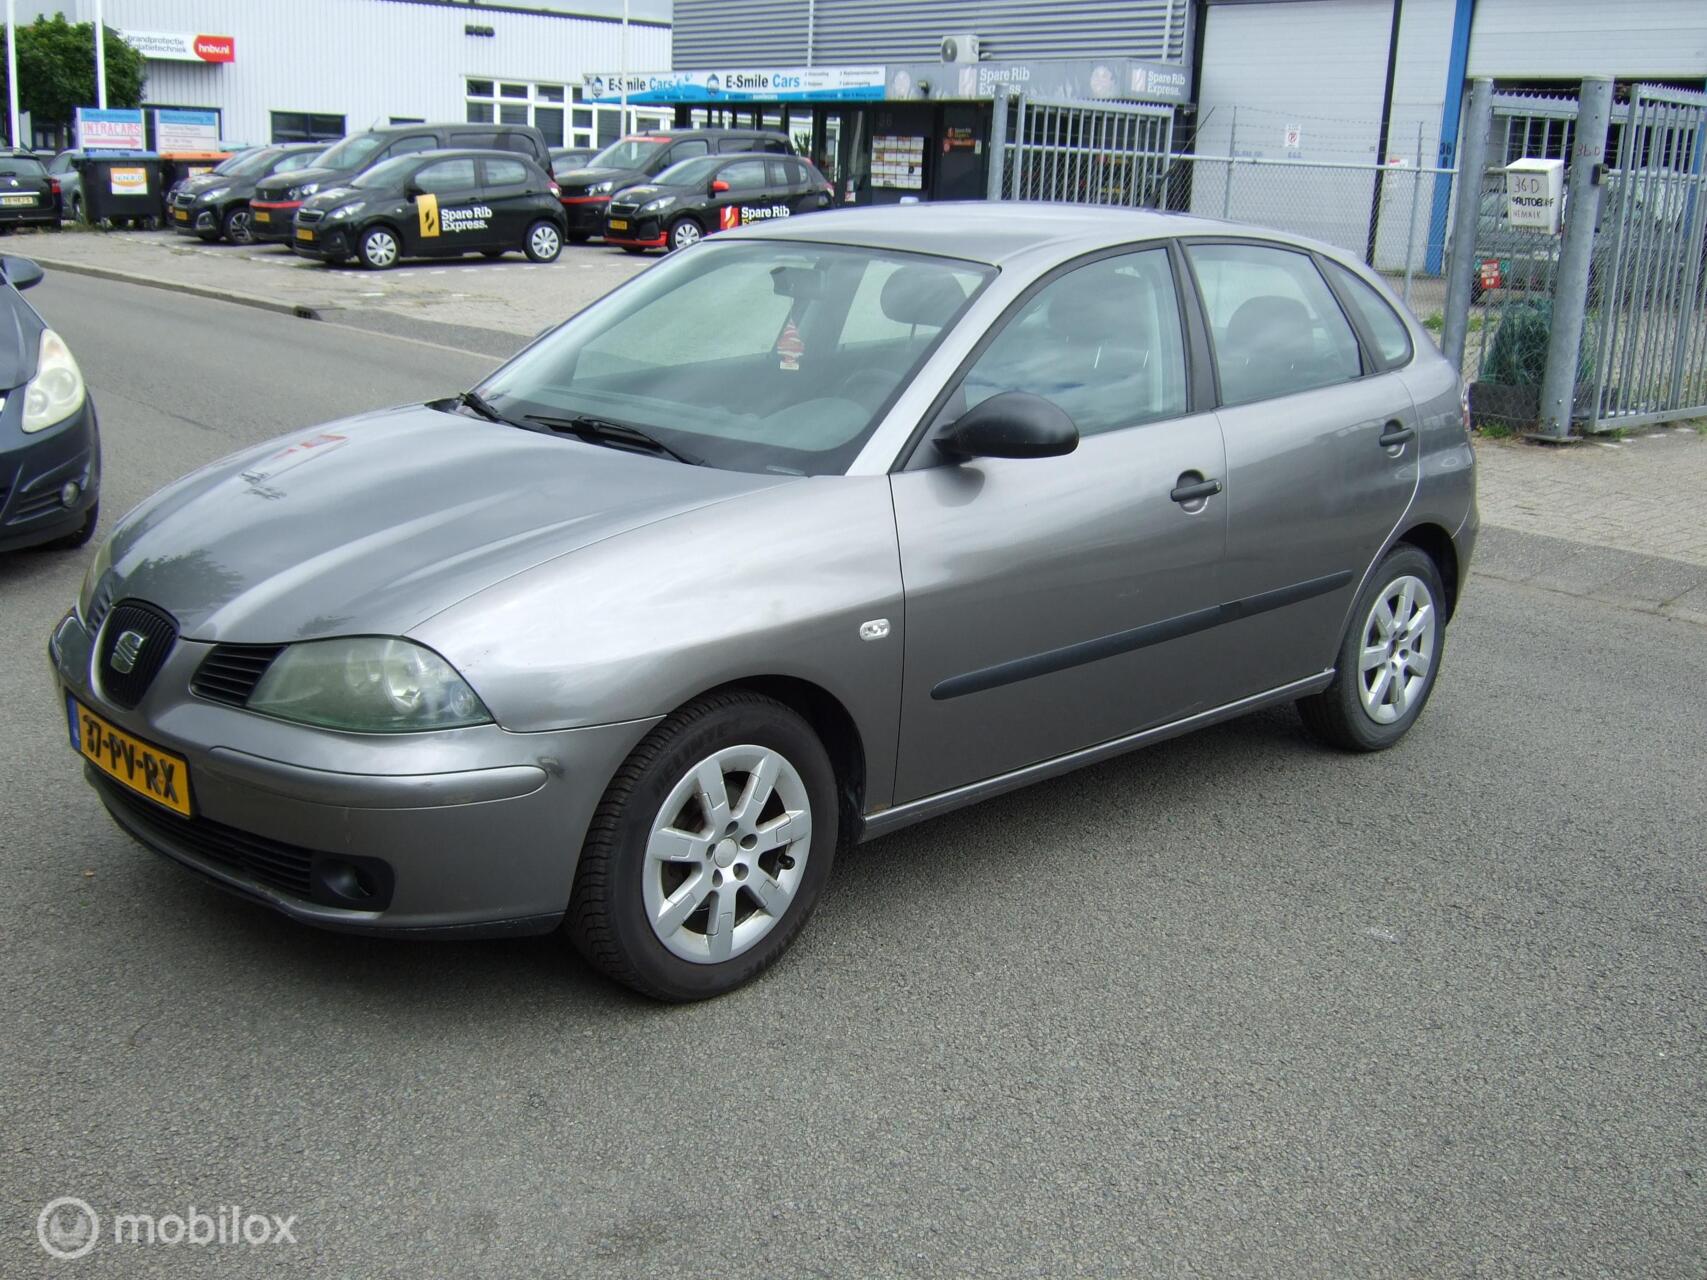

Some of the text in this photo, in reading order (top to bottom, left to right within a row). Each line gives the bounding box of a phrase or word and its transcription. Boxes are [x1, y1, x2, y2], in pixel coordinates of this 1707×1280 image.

[198, 42, 230, 54] hnbv.nl
[726, 74, 769, 88] E-Smile
[772, 73, 800, 88] Cars
[980, 67, 1030, 83] Spare Rib
[1147, 71, 1186, 85] Spare Rib
[649, 76, 673, 90] Cars
[1147, 82, 1182, 96] Express.
[1439, 142, 1453, 155] 36
[1531, 178, 1540, 193] D
[441, 206, 493, 221] Spare Rib
[741, 204, 790, 220] Spare Rib
[442, 219, 489, 232] Express.
